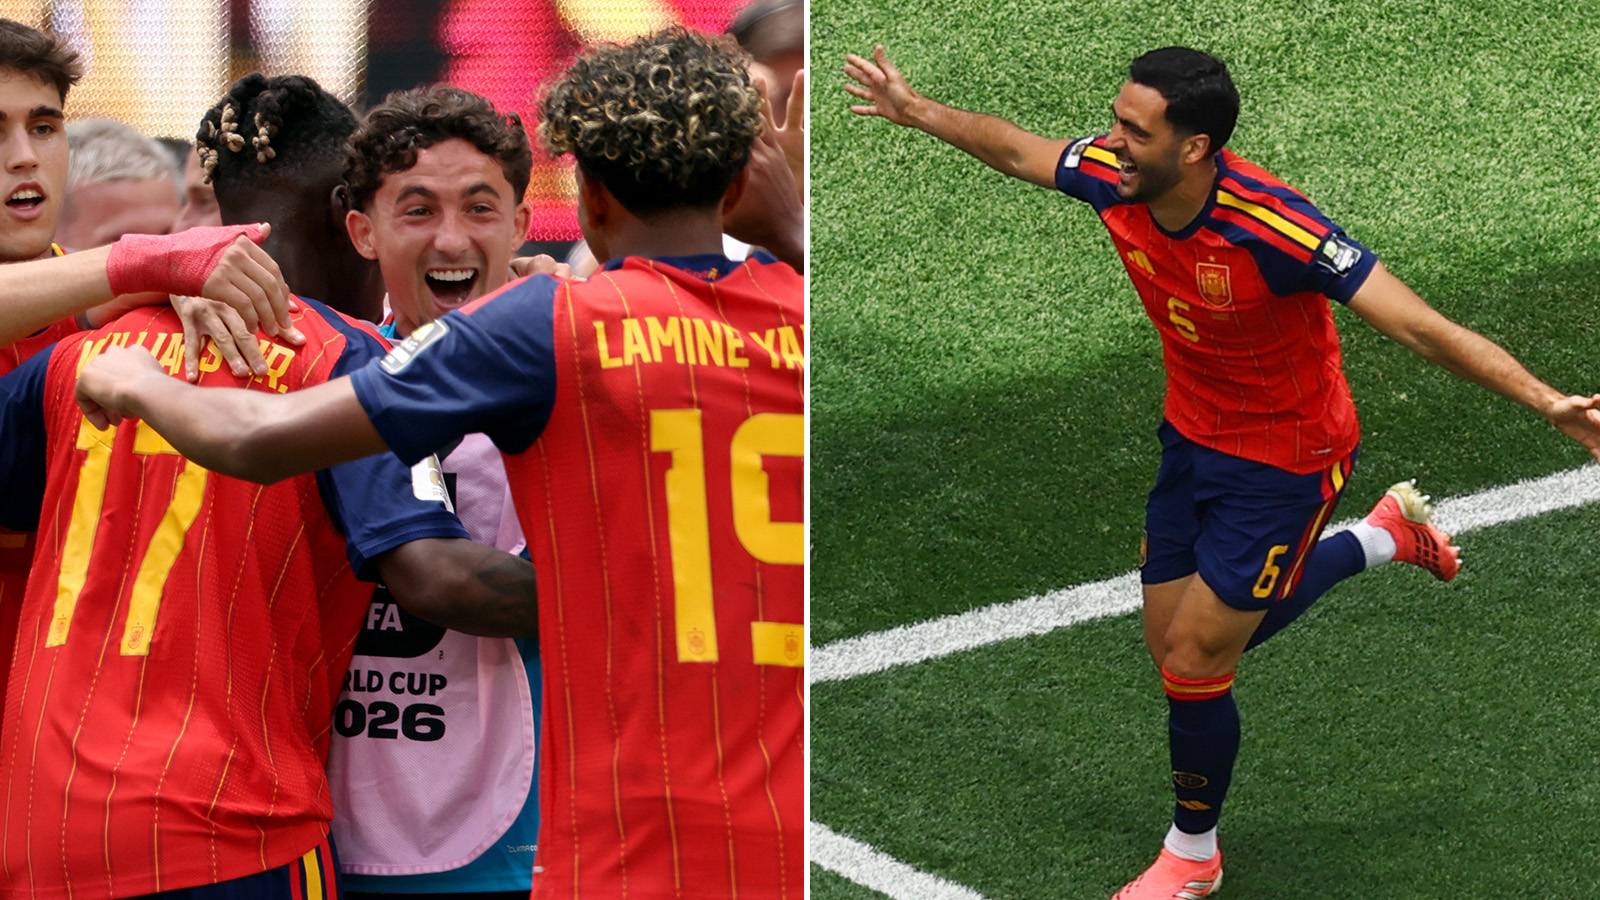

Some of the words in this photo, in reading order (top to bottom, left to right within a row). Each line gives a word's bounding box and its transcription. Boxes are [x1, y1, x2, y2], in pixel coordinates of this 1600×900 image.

[593, 317, 750, 369] LAMINE
[749, 324, 804, 370] YA
[45, 414, 208, 656] 17
[650, 408, 804, 667] 19
[1252, 544, 1289, 598] 6
[367, 602, 403, 632] FA
[343, 669, 384, 693] RLD
[389, 671, 447, 696] CUP
[331, 699, 446, 742] 026
